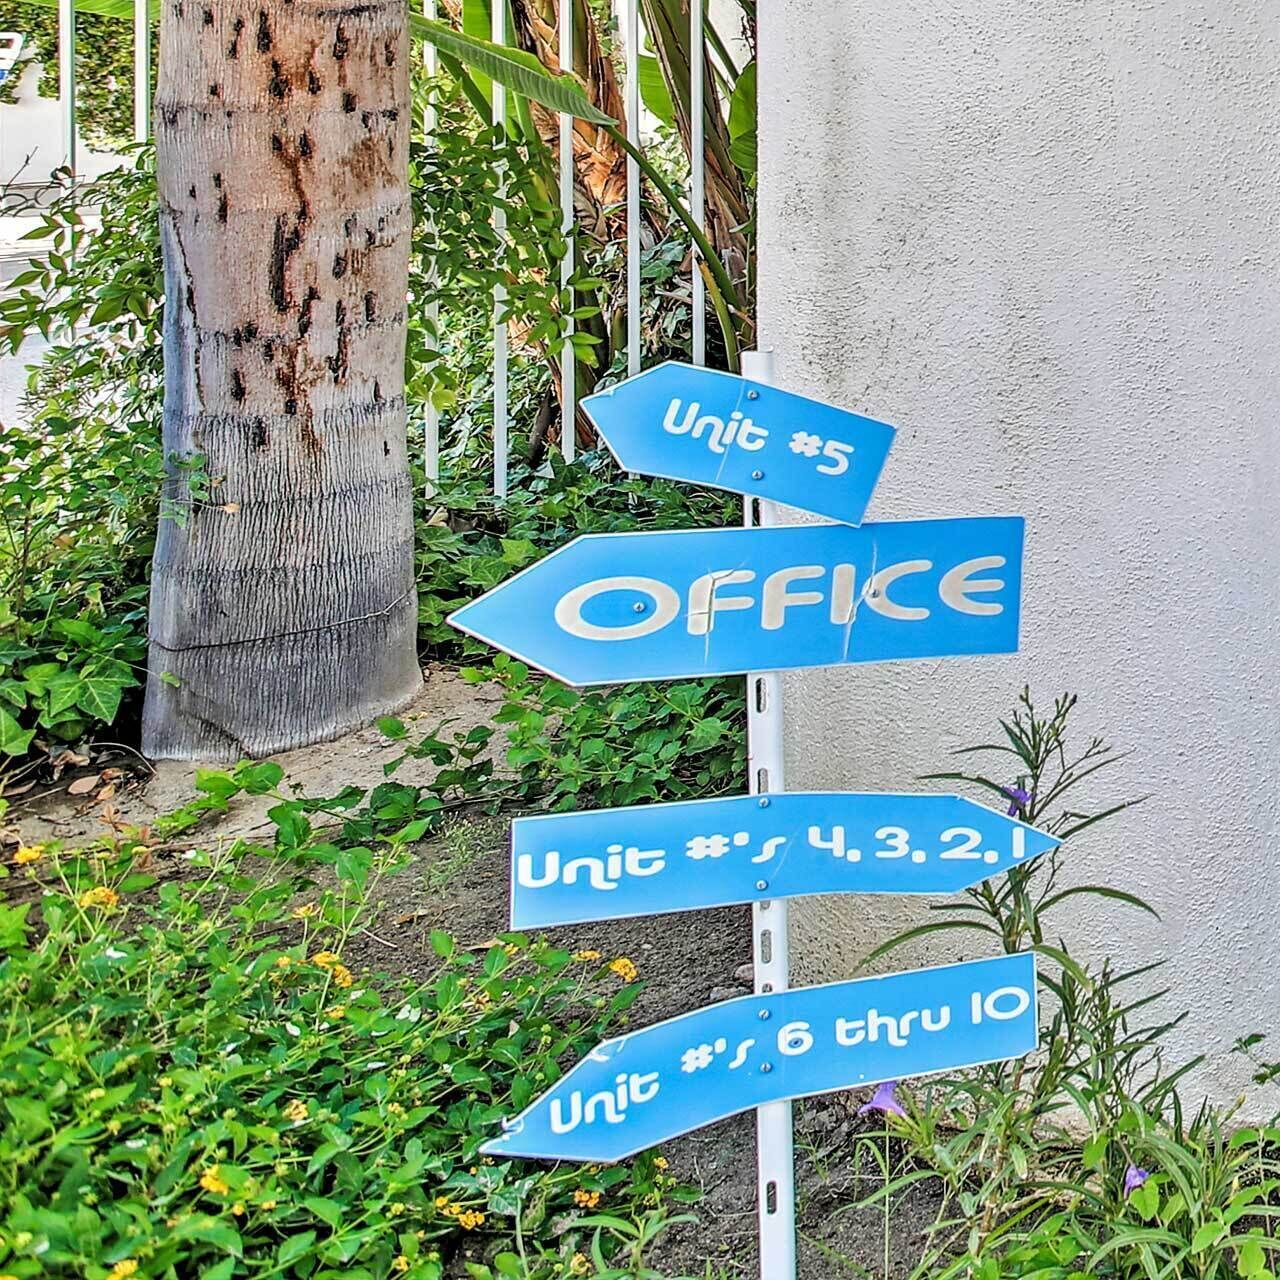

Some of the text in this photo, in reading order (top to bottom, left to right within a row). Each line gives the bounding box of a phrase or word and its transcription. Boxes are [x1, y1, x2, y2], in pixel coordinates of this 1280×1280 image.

[662, 398, 855, 476] Unit #5
[553, 555, 1007, 641] OFFICE
[516, 844, 666, 891] Unit
[685, 831, 787, 864] #'s
[549, 986, 1031, 1135] Unit #'s 6 thru 10
